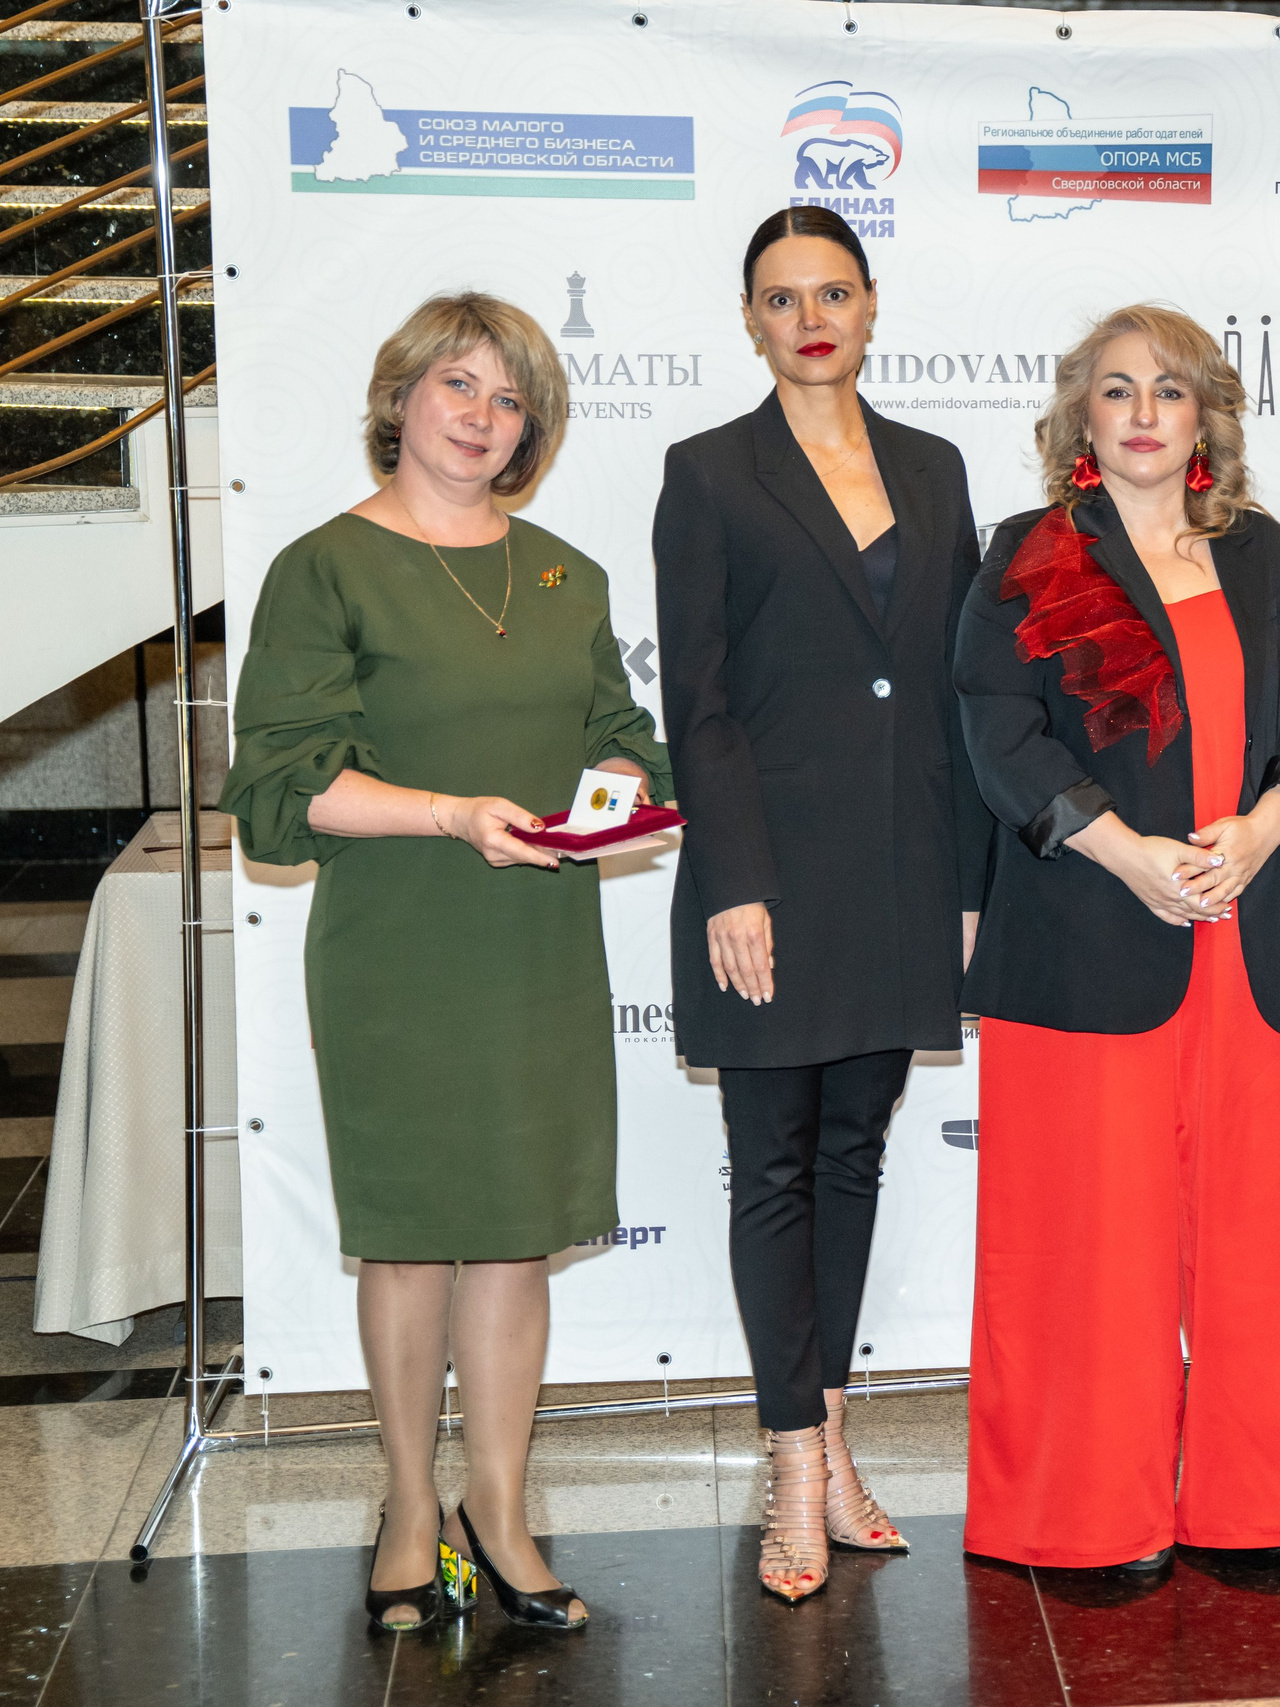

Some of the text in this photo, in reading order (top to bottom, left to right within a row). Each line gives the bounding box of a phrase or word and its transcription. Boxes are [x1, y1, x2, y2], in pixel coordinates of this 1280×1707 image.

[418, 118, 564, 133] СОЮЗ МАЛОГО
[983, 125, 1054, 140] Региональное
[1056, 126, 1123, 139] объединение
[419, 135, 636, 151] И СРЕДНЕГО БИЗНЕСА
[419, 151, 674, 168] СВЕРДЛОВСКОЙ ОБЛАСТИ
[1100, 150, 1202, 167] ОПОРА МСБ
[1051, 177, 1201, 191] Свердловской области
[558, 353, 702, 386] МАТЫ
[567, 402, 652, 419] EVENTS
[871, 397, 1041, 409] www.demidovamedia.ru
